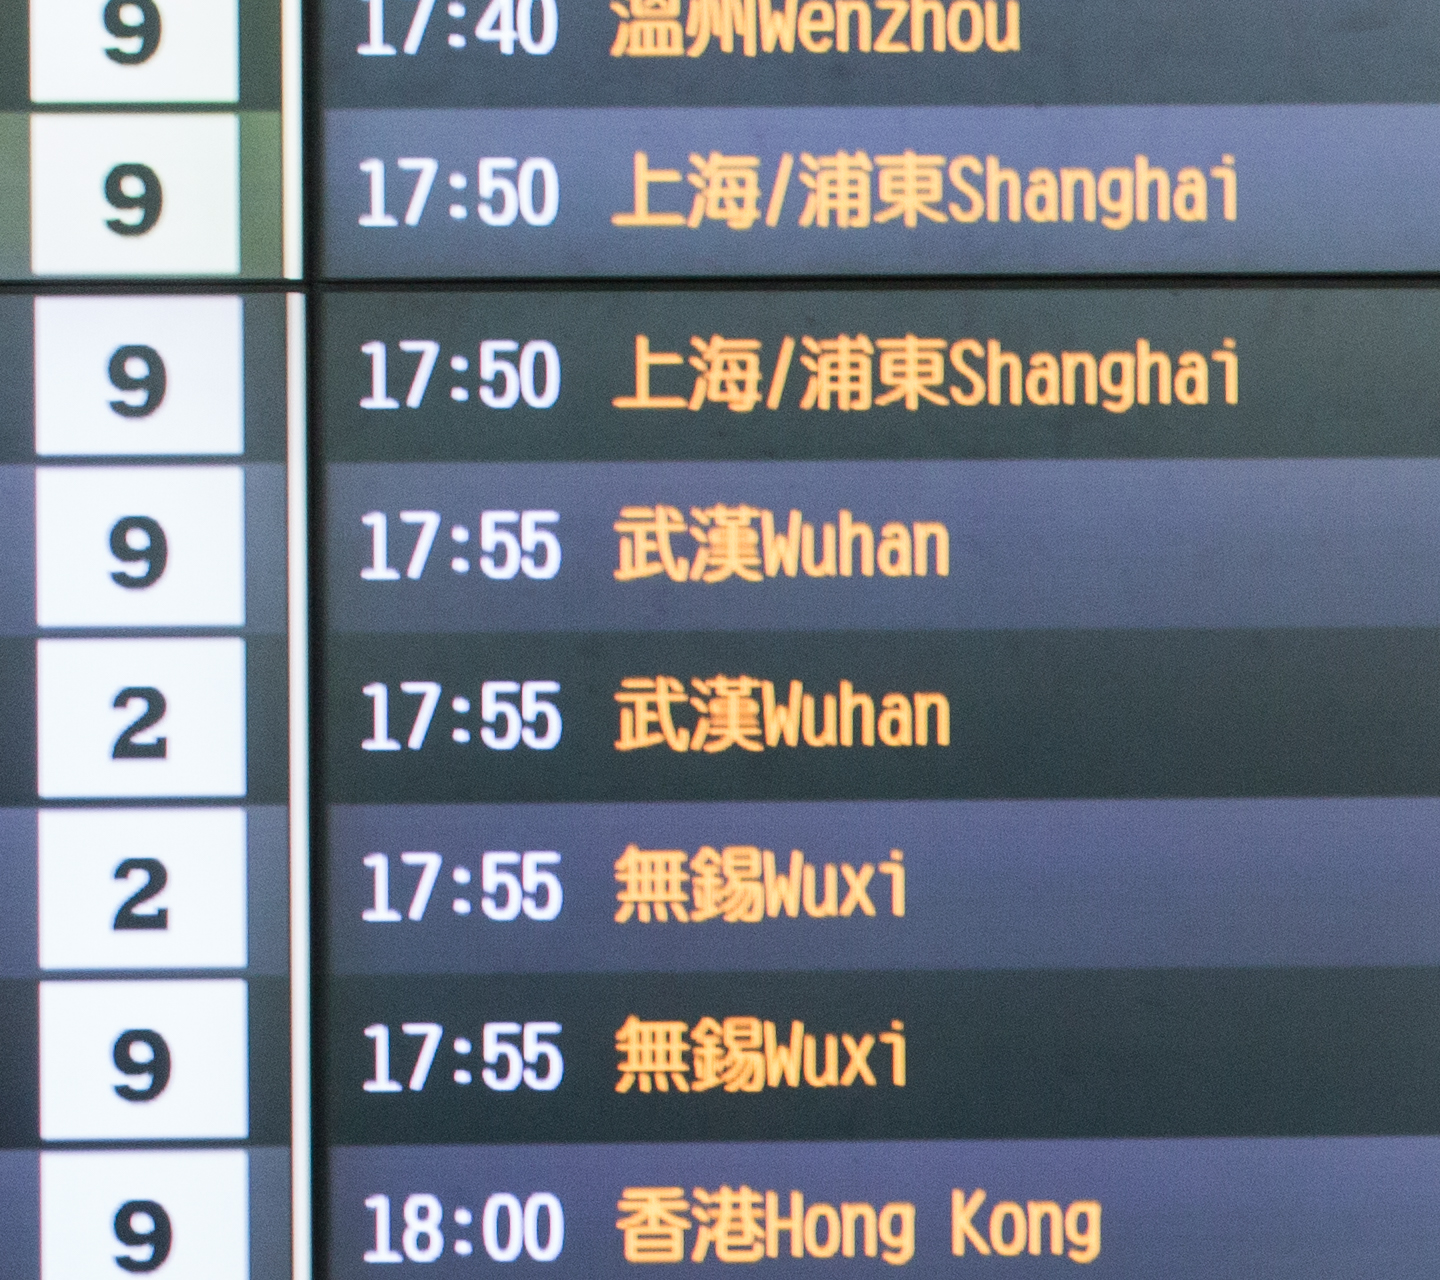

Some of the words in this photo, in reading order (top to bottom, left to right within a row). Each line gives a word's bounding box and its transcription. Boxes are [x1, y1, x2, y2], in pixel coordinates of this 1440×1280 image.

[103, 162, 164, 237] 9
[358, 156, 560, 228] 17:50
[107, 344, 167, 419] 9
[359, 339, 561, 410] 17:50
[108, 515, 169, 590] 9
[360, 509, 562, 581] 17:55
[111, 686, 168, 760] 2
[361, 680, 563, 751] 17:55
[112, 857, 169, 931] 2
[361, 850, 564, 923] 17:55
[111, 1028, 172, 1103] 9
[362, 1021, 564, 1093] 17:55
[112, 1199, 173, 1274] 9
[363, 1192, 565, 1264] 18:00
[950, 1188, 1102, 1265] Kong
